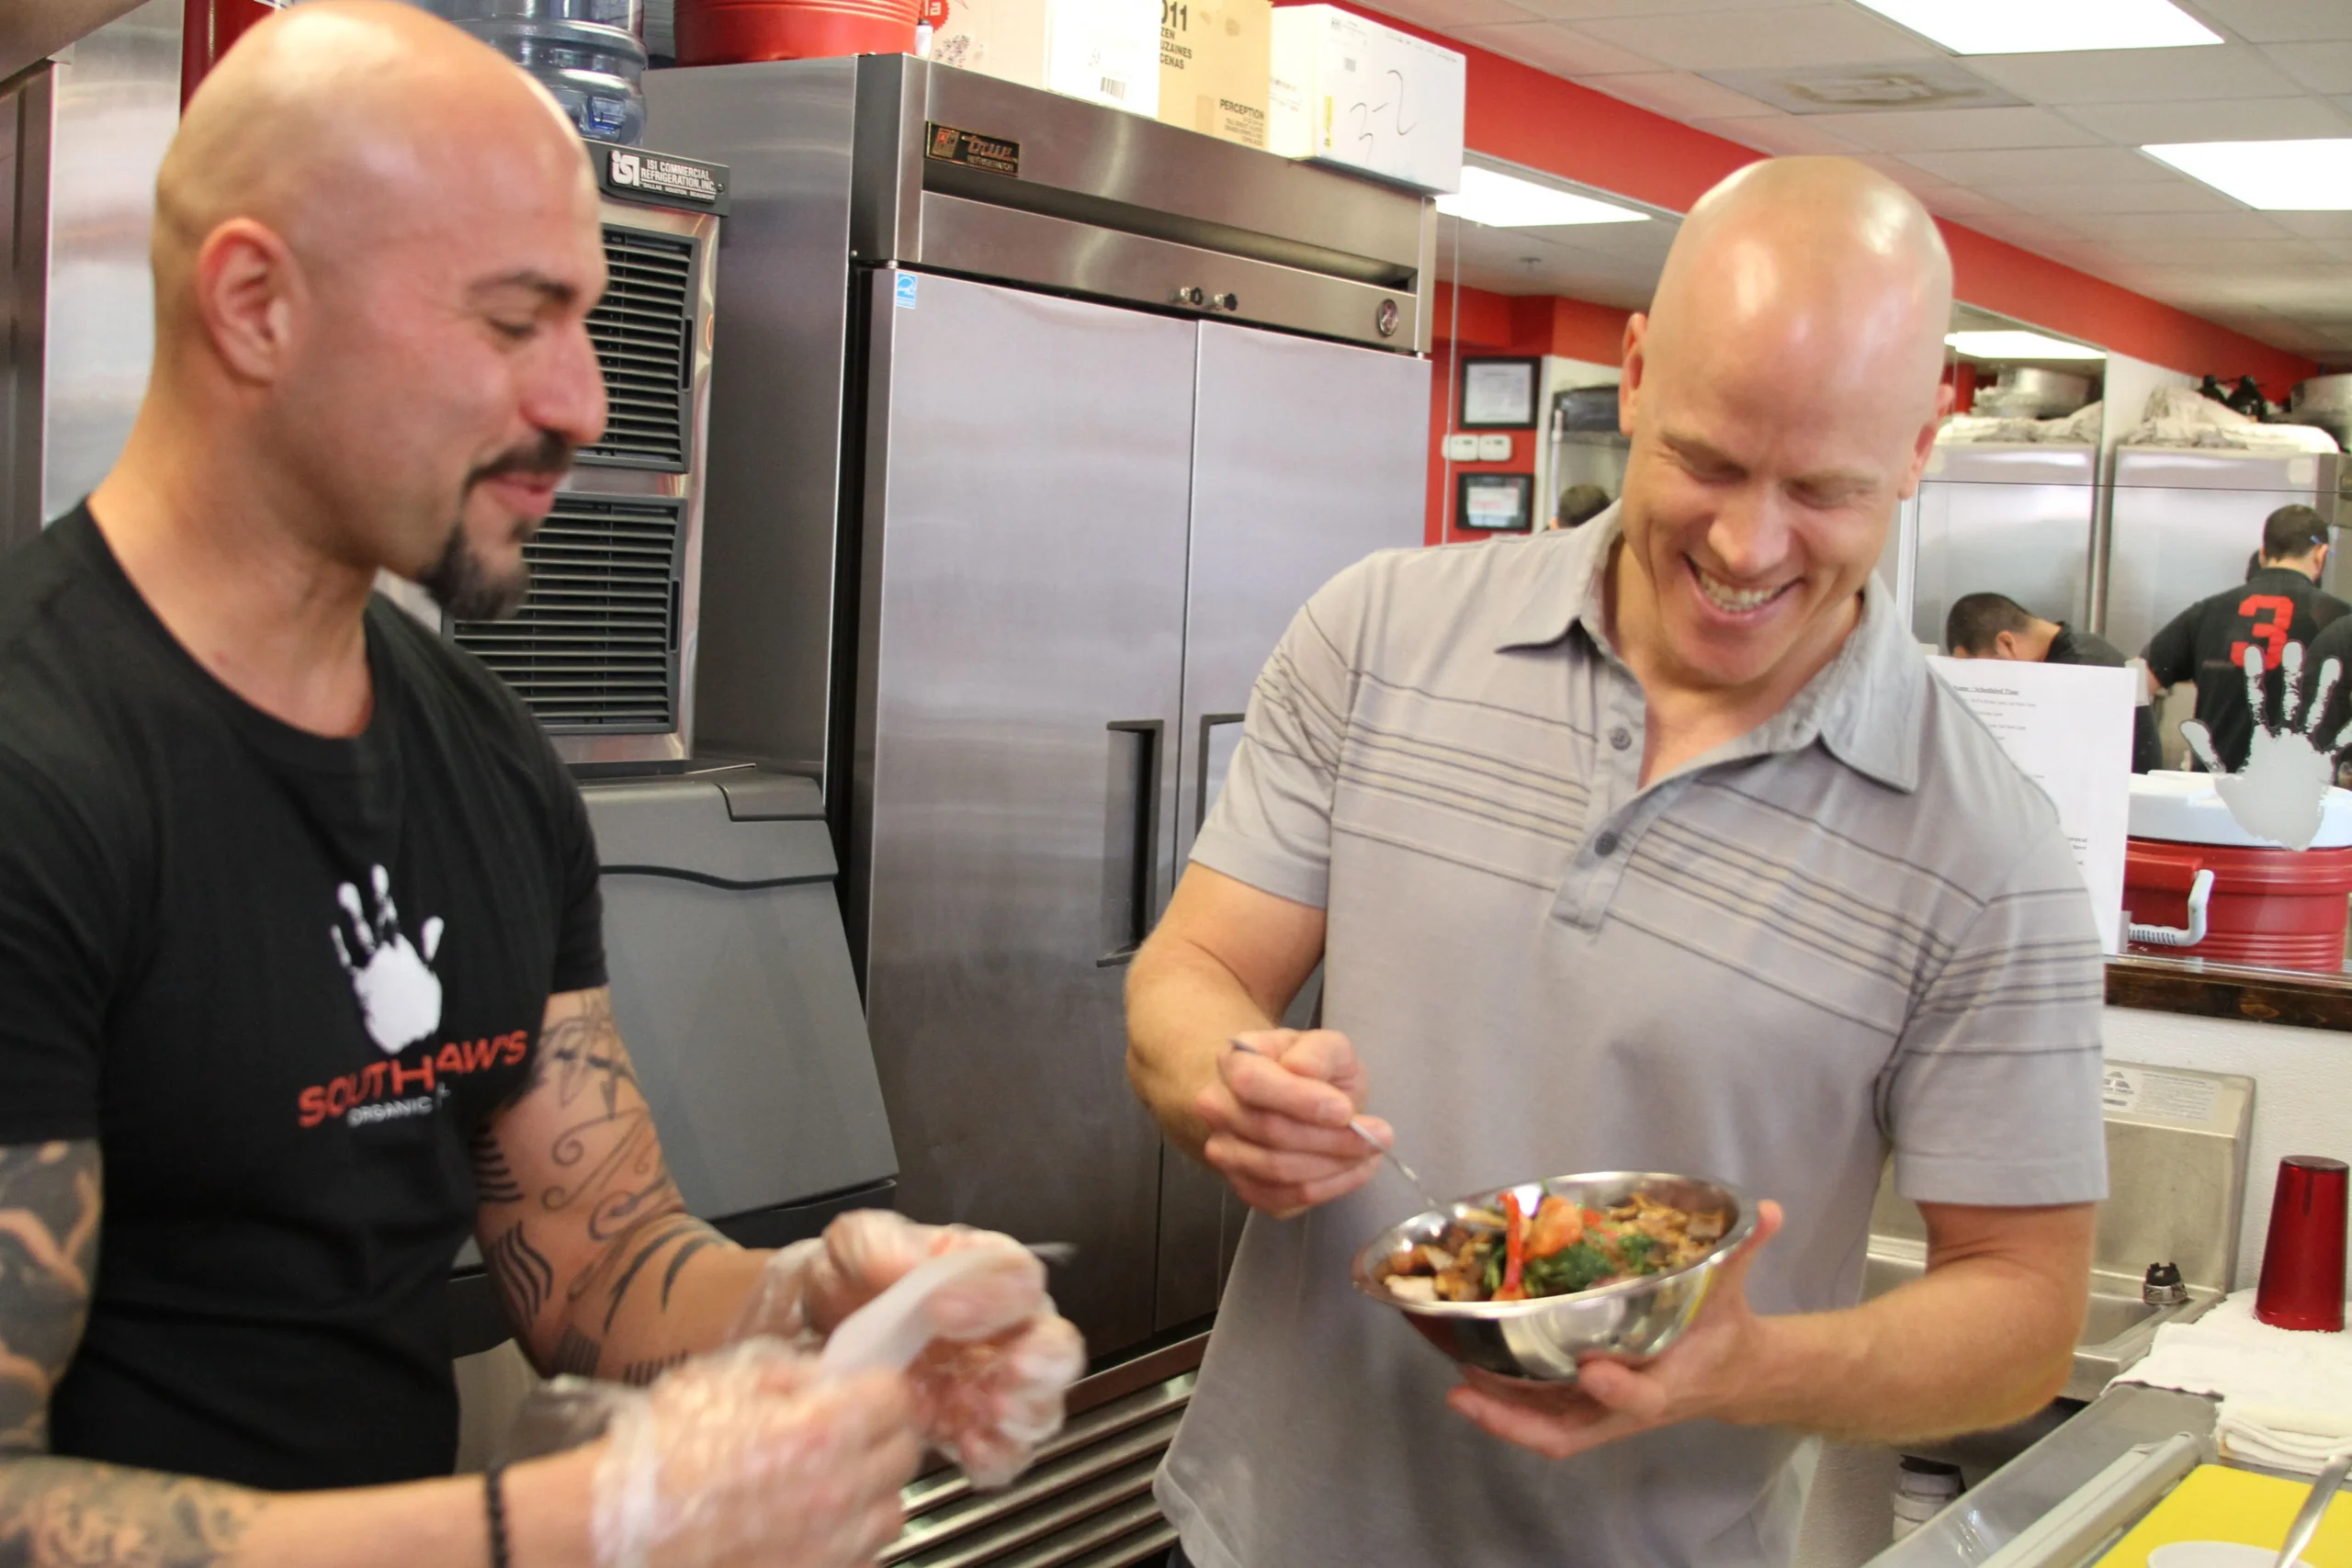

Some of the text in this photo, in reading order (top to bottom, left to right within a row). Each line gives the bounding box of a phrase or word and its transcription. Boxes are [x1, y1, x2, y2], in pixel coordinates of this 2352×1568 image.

[1160, 27, 1175, 39] ZEN
[1160, 41, 1193, 59] UZAINES
[1159, 53, 1184, 70] CENAS
[1219, 98, 1265, 120] PERCEPTION
[647, 159, 709, 180] ISI COMMERCIAL
[2230, 594, 2294, 671] 3
[347, 1096, 433, 1127] ORGANIC
